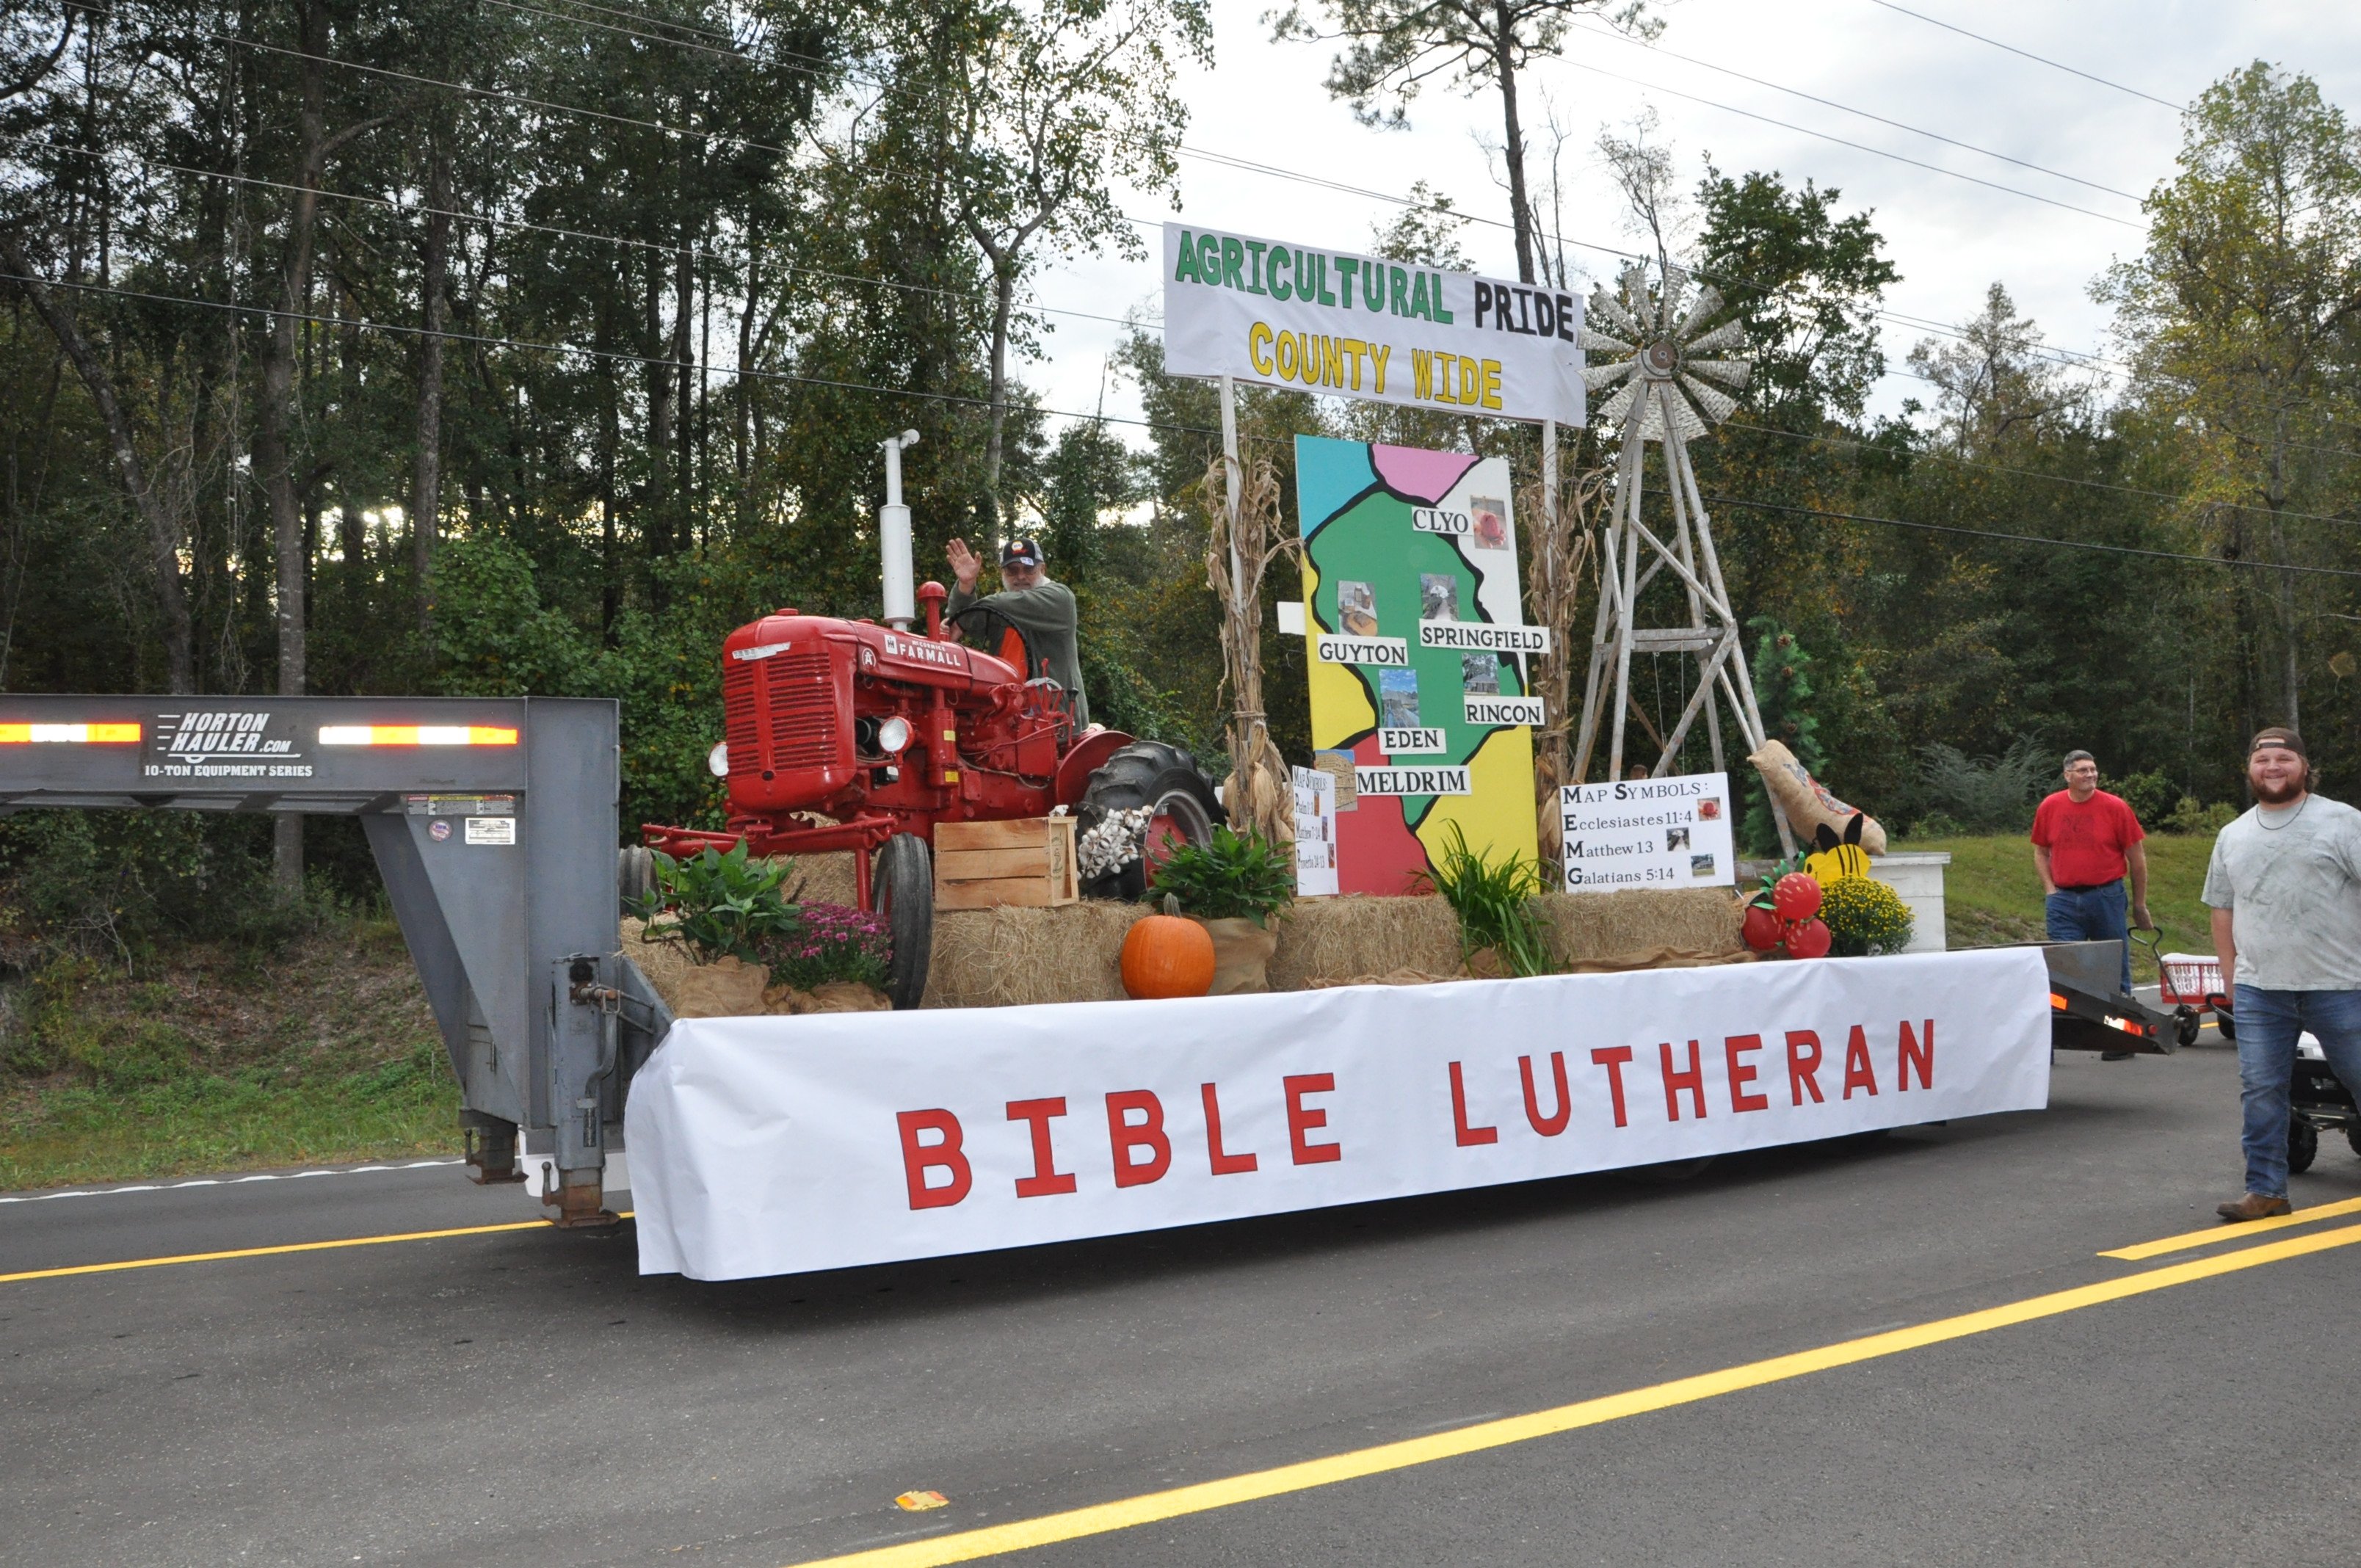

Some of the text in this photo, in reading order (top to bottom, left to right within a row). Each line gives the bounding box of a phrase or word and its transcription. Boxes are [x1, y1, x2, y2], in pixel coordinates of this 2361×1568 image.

[1175, 230, 1574, 343] AGRICULTURAL PRIDE
[1250, 322, 1503, 411] COUNTY WIDE
[1412, 509, 1469, 533] CLYO
[1421, 626, 1544, 650] SPRINGFIELD
[899, 643, 961, 667] FARMALL
[1319, 642, 1406, 664] GUYTON
[178, 712, 270, 732] HORTON
[1465, 704, 1541, 723] RINCON
[1384, 729, 1440, 749] EDEN
[145, 765, 313, 777] 10-TON EQUIPMENT SERIES
[1356, 770, 1468, 794] MELDRIM
[1563, 785, 1608, 805] MAP
[1563, 810, 1693, 832] Ecclesiastes 11:4
[1564, 841, 1654, 859] Matthew 13
[1567, 867, 1675, 885] Galatians 5:14
[896, 1019, 1934, 1211] BIBLE LUTHERAN
